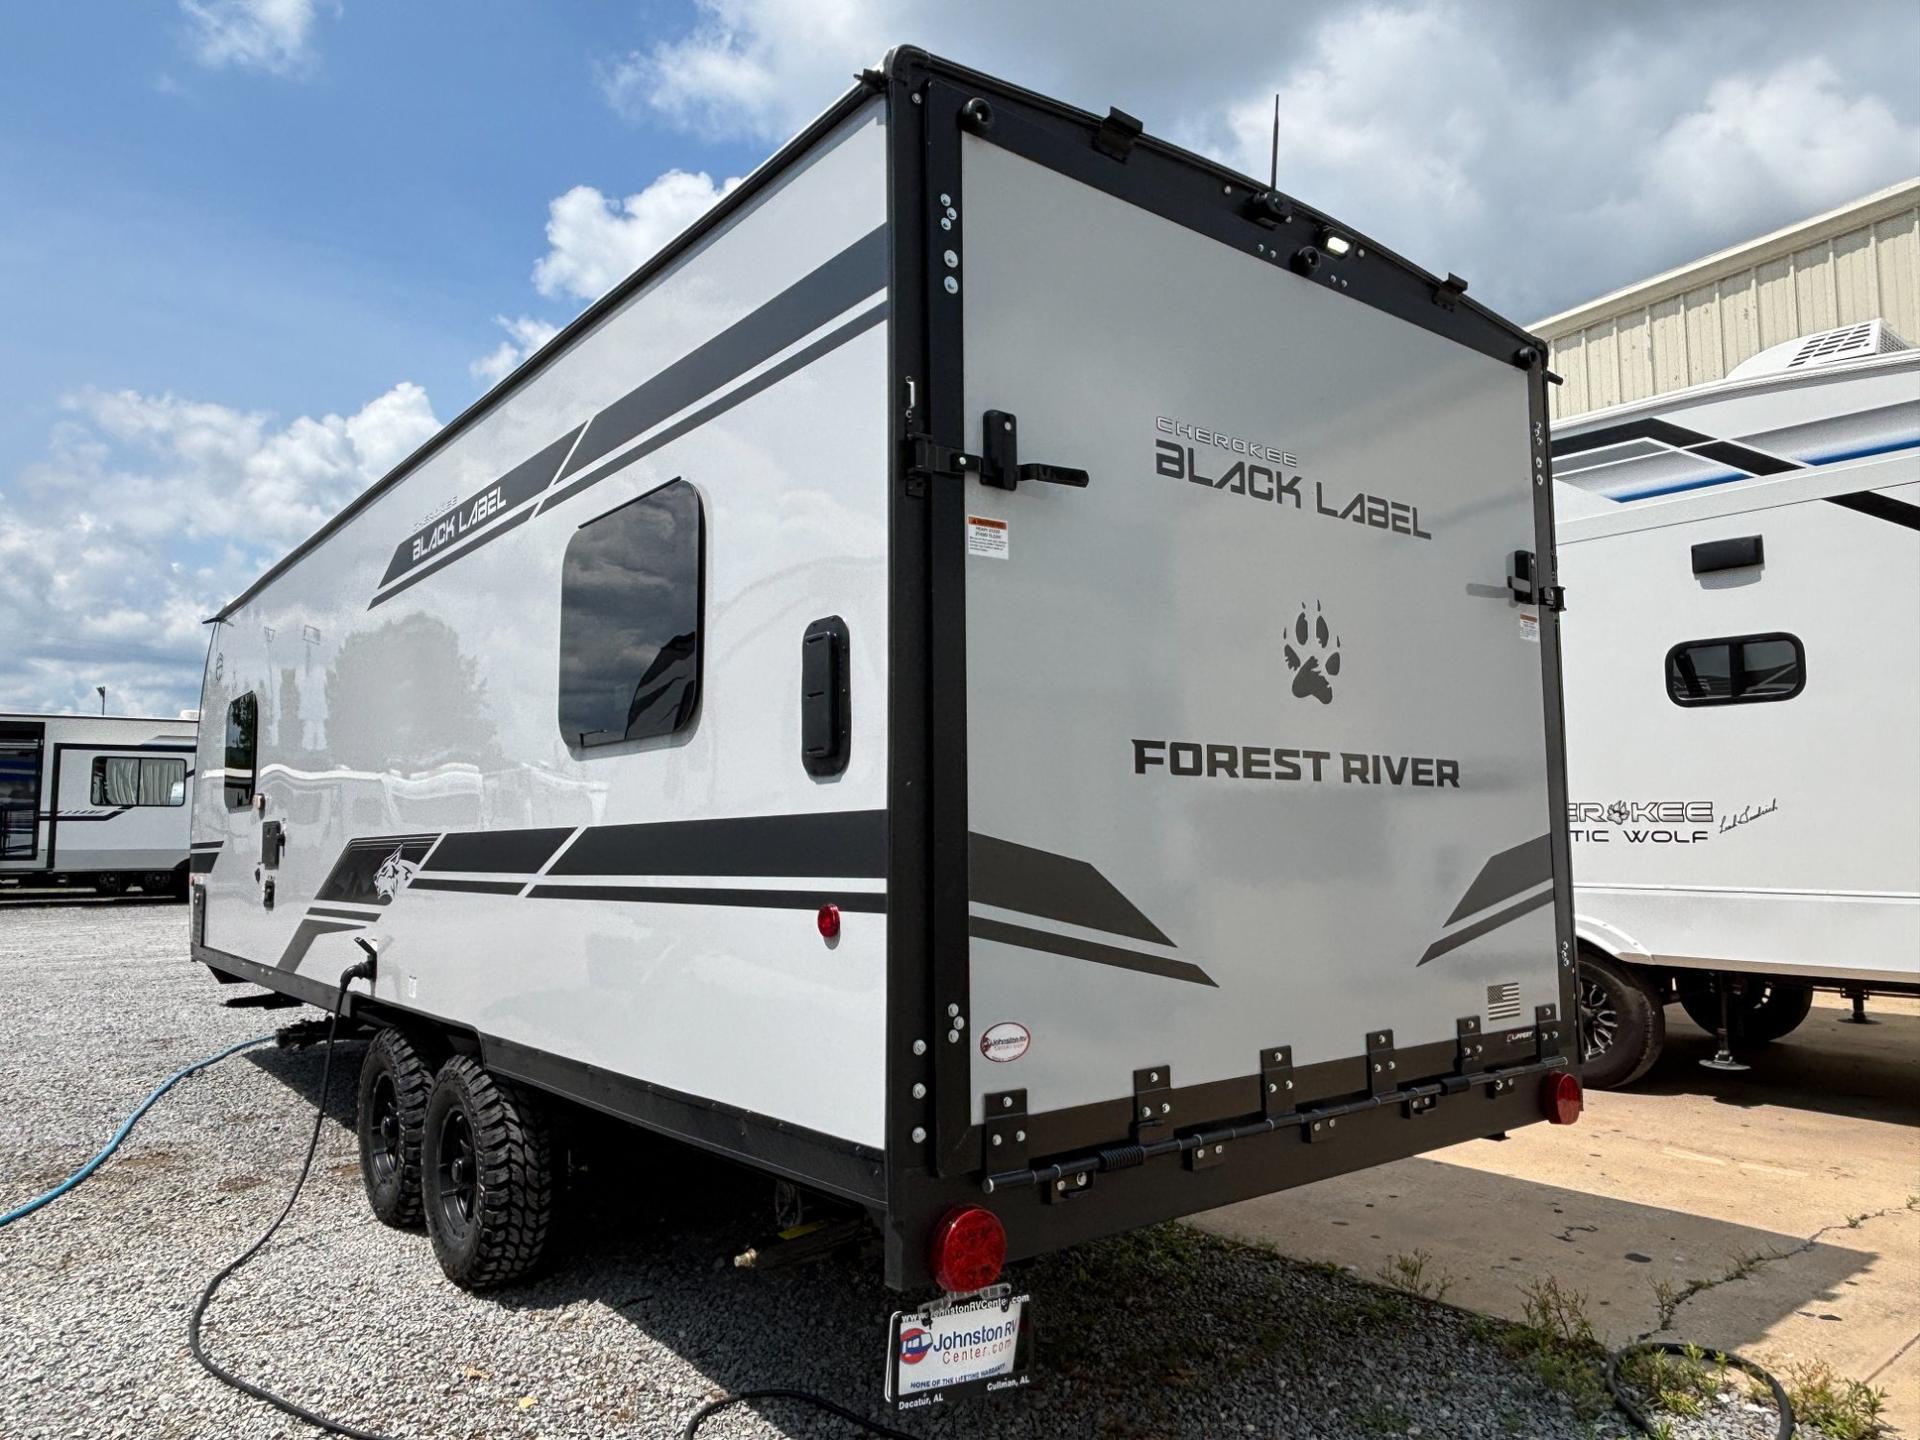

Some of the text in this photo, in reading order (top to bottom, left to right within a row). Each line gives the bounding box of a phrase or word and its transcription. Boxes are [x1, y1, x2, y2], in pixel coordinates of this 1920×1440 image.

[1155, 415, 1298, 468] CHEROKEE
[1155, 438, 1432, 541] BLACK LABEL
[412, 515, 456, 561] BLACK
[458, 486, 507, 532] LABEL
[1131, 739, 1461, 788] FOREST RIVER
[1623, 830, 1709, 844] WOLF
[933, 1319, 1018, 1352] Johnston RV
[943, 1338, 1012, 1364] Center.com
[1020, 1375, 1030, 1385] AL
[933, 1393, 944, 1403] AL
